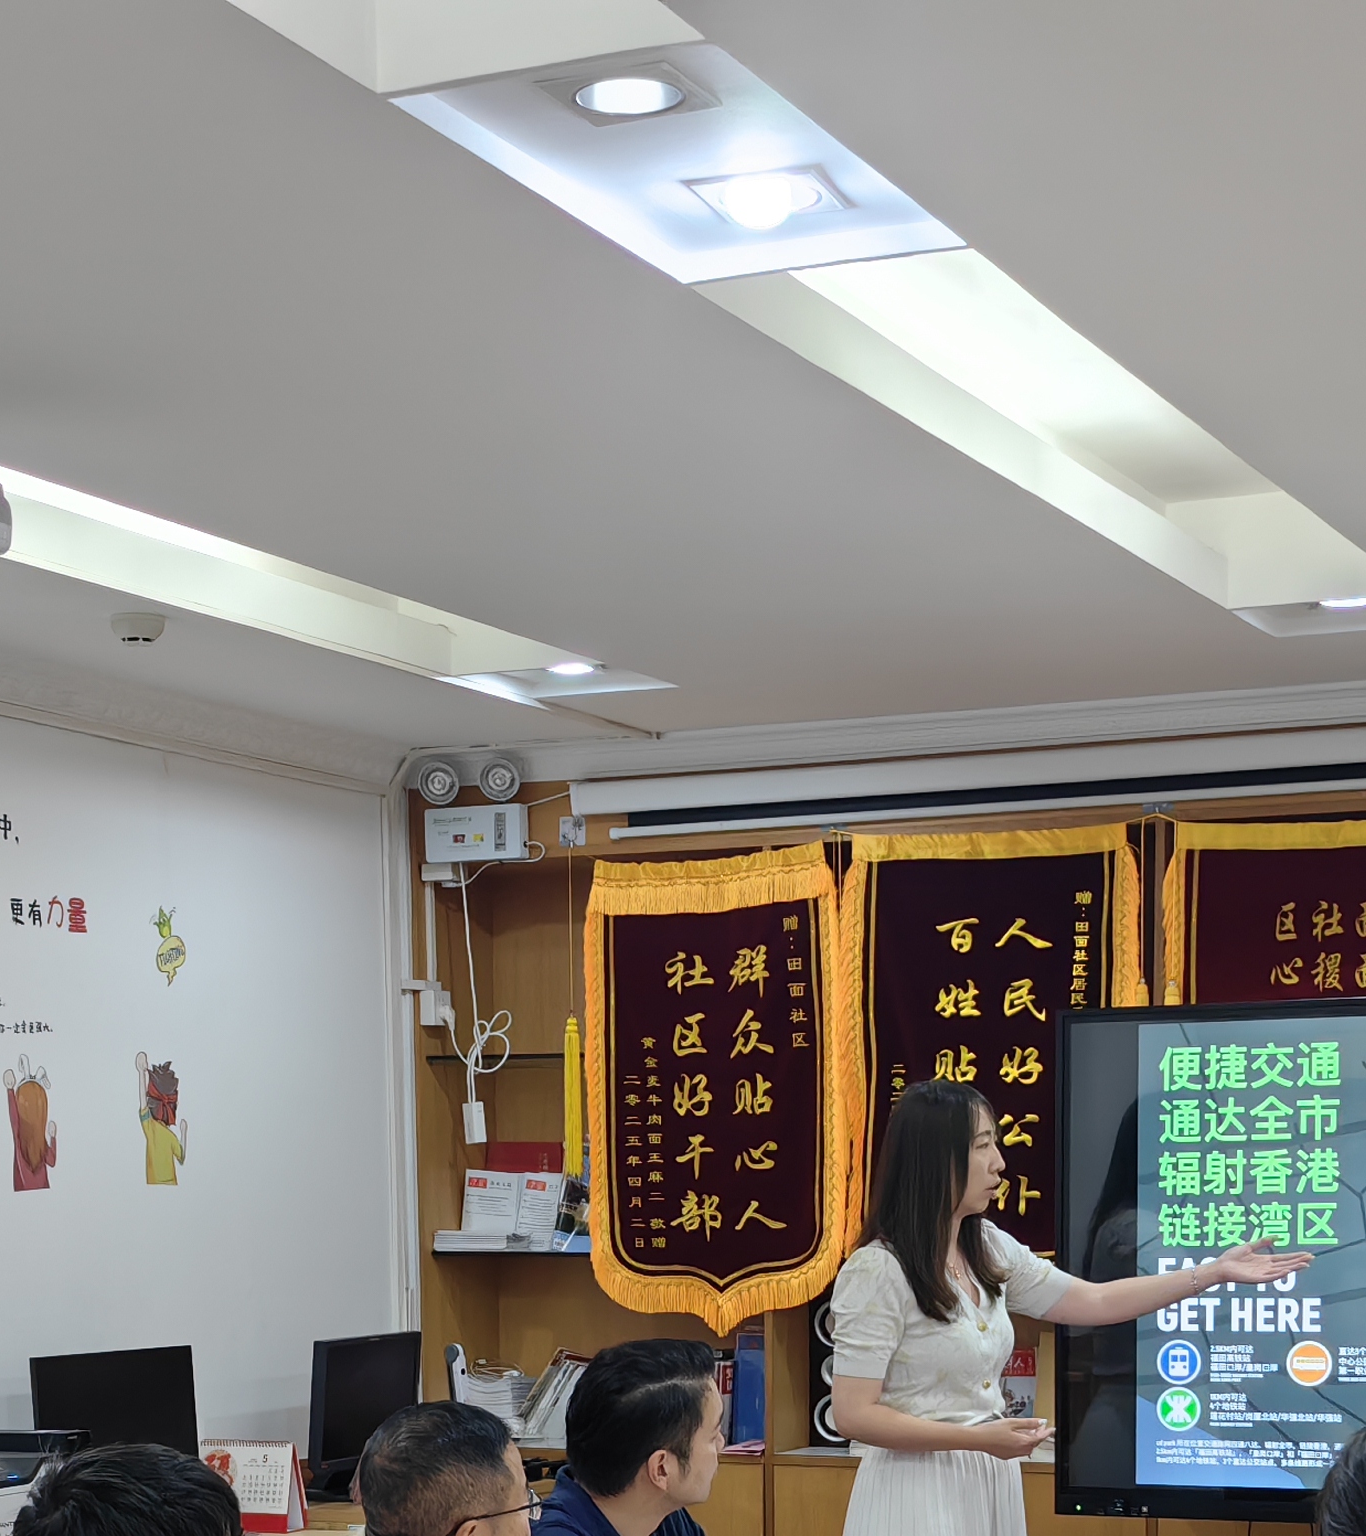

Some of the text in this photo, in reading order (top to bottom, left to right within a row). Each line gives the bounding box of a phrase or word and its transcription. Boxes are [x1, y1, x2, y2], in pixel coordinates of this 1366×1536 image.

[10, 895, 88, 933] 更有力量
[1070, 890, 1092, 1010] 赠：田面社区居民
[935, 918, 981, 1083] 百姓贴
[665, 951, 723, 1242] 社区好干部
[728, 944, 787, 1230] 群众贴心人
[990, 918, 1053, 1216] 人民好公仆
[1159, 1042, 1341, 1091] 便捷交通
[1159, 1094, 1340, 1143] 通达全市
[623, 1075, 646, 1248] 二零二五年四月二日
[1158, 1148, 1340, 1195] 辐射香港
[1158, 1202, 1338, 1247] 链接湾区
[1156, 1297, 1322, 1332] GET HERE
